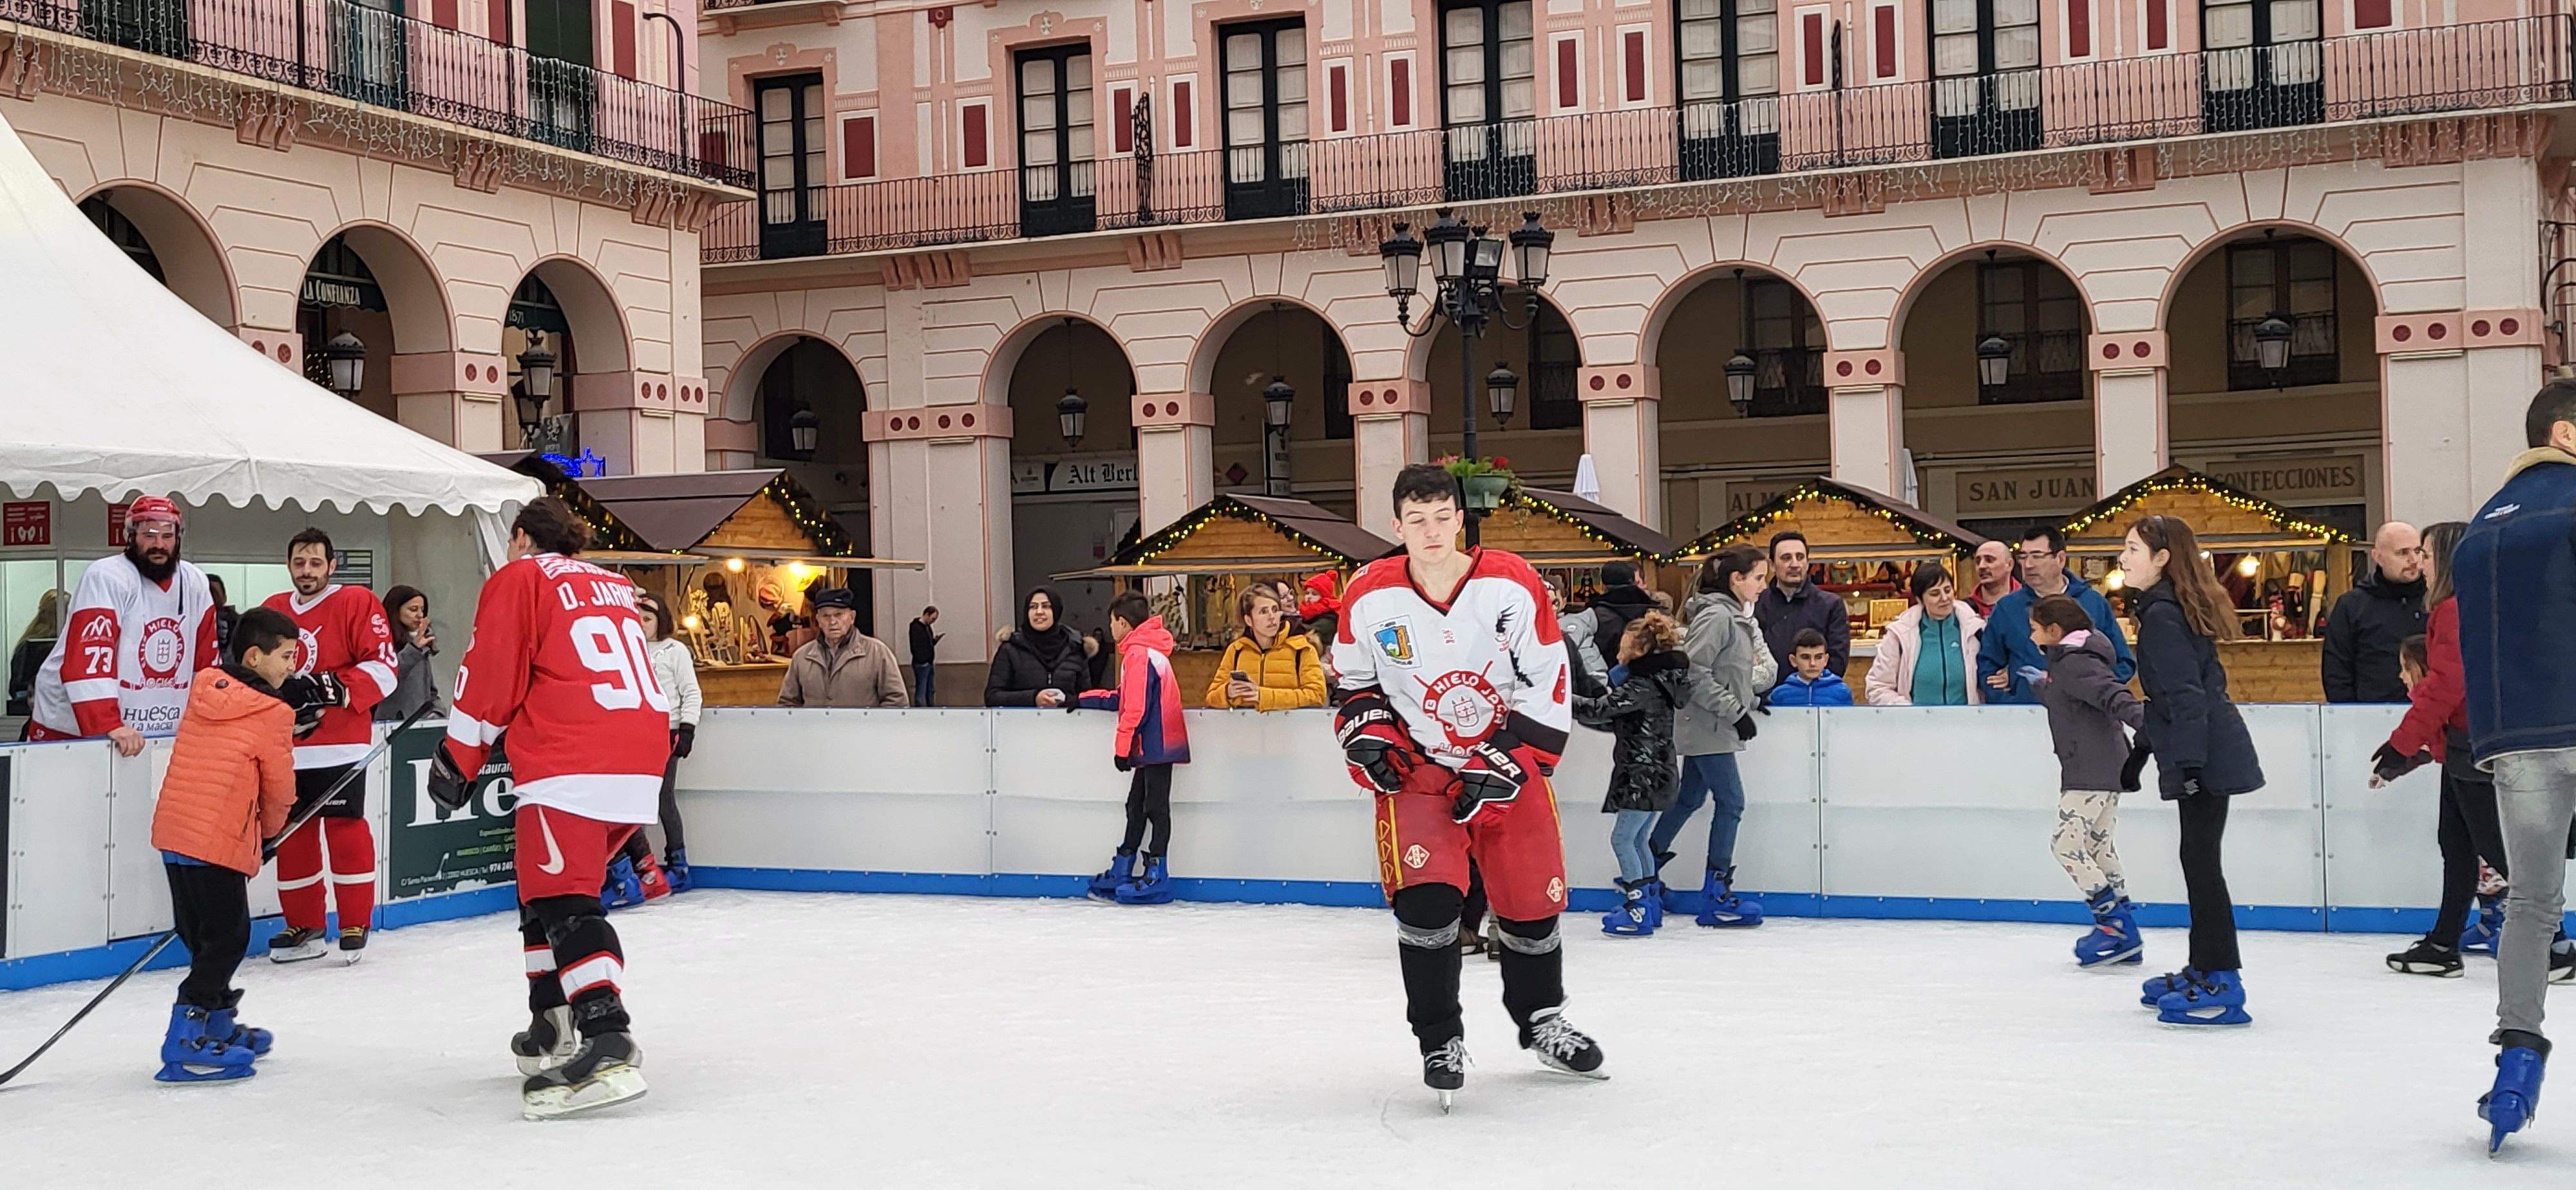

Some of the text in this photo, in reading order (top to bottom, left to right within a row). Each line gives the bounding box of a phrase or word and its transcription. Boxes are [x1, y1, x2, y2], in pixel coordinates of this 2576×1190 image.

[303, 278, 361, 305] LA CONFIANZA
[1068, 463, 1137, 484] Alt Berl
[1969, 478, 2096, 501] SAN JUAN
[84, 646, 113, 674] 73
[569, 615, 670, 712] 90
[1433, 673, 1479, 694] HIELO
[1338, 709, 1394, 744] BAUER
